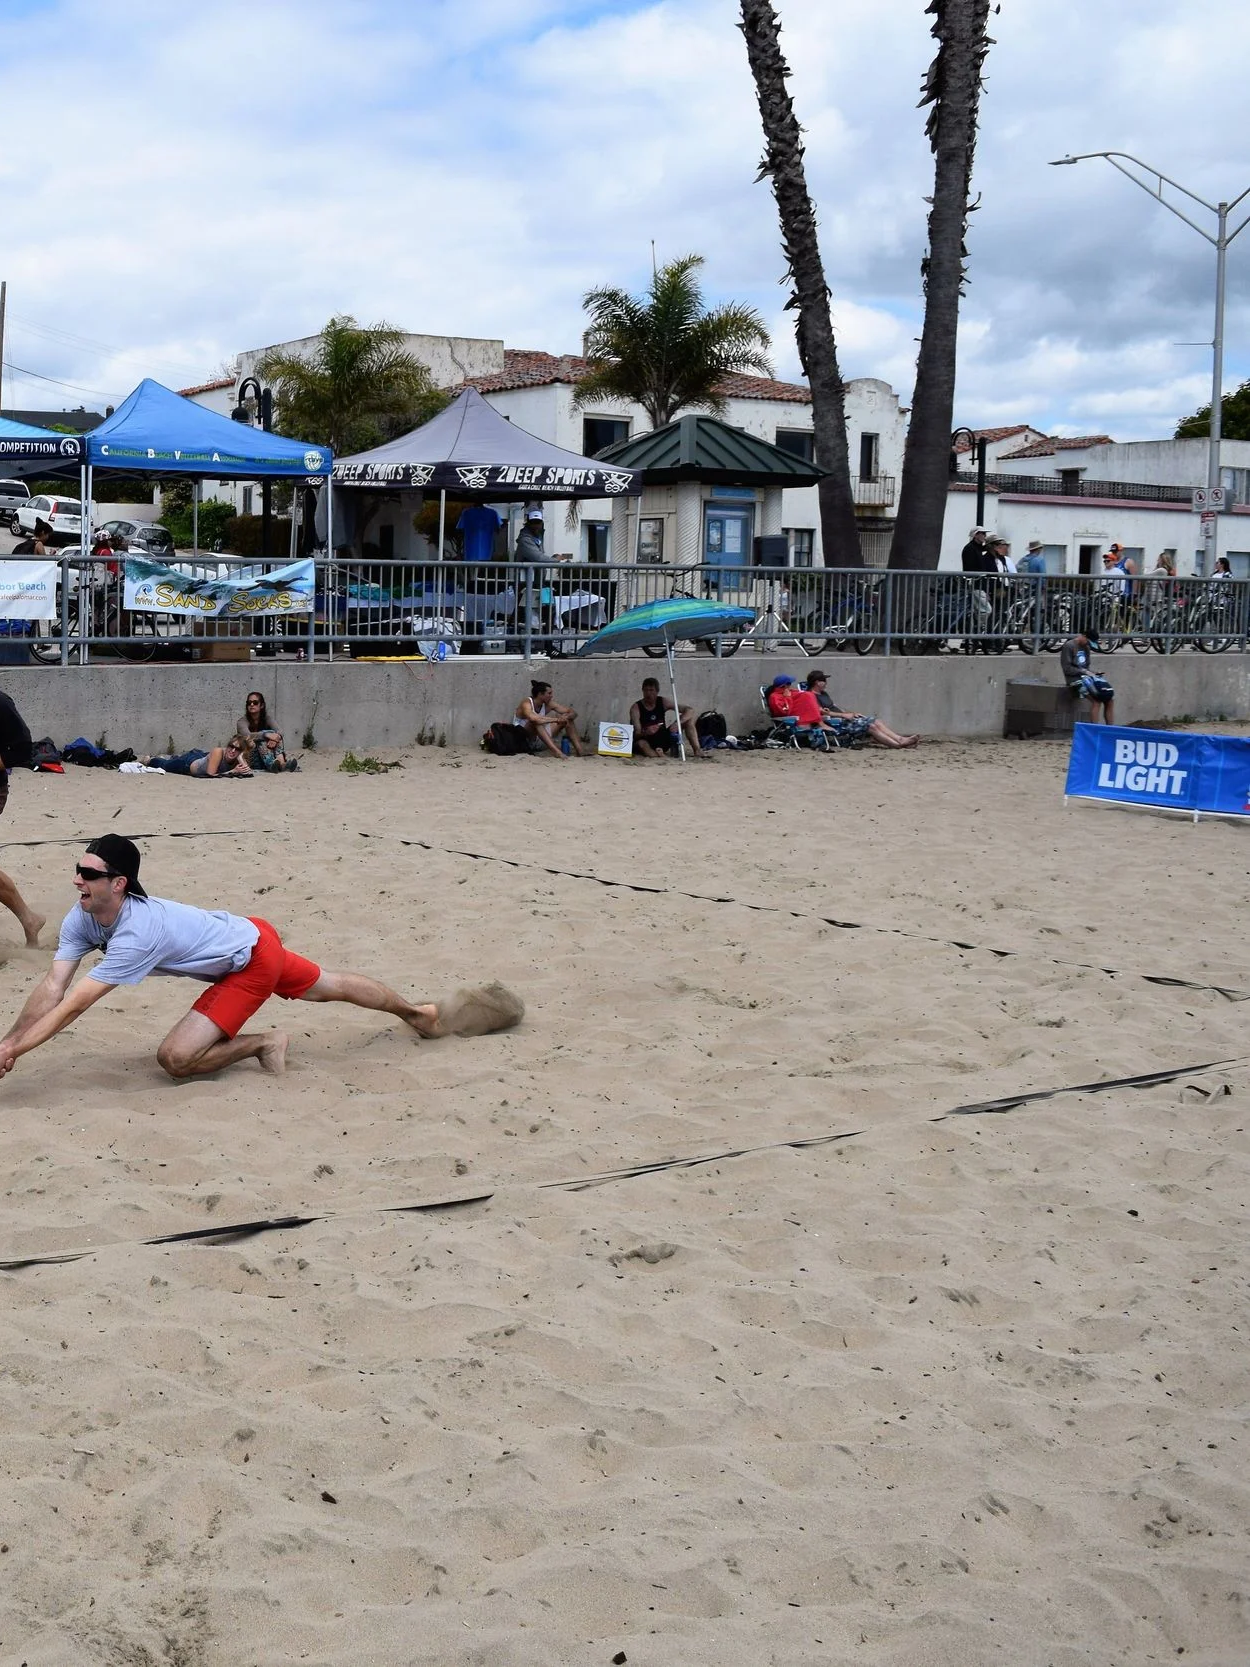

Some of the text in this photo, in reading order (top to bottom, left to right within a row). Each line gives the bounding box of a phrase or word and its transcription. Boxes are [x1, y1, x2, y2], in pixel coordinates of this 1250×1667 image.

[332, 463, 407, 480] 2DEEP SPORTS
[496, 465, 597, 486] 2DEEP SPORTS
[18, 582, 46, 591] Beach
[1114, 739, 1179, 768] BUD
[1097, 763, 1188, 795] LIGHT
